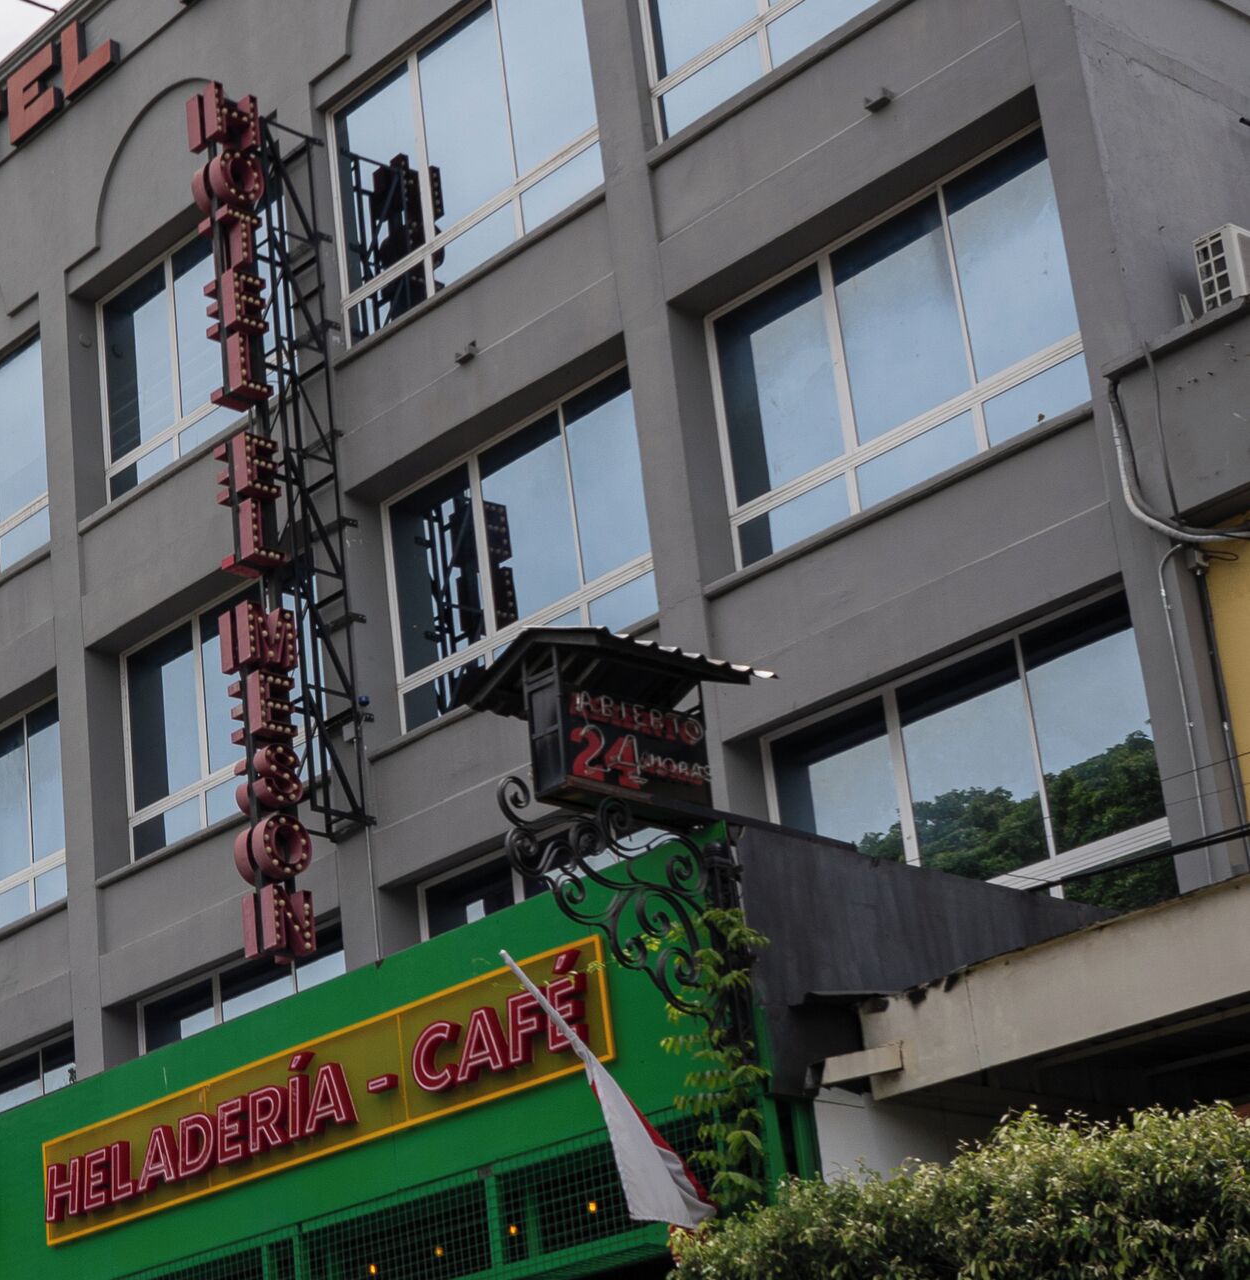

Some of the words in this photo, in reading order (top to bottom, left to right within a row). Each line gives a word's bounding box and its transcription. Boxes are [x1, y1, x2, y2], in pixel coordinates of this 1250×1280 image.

[186, 80, 274, 412] HOTEL
[214, 431, 286, 578] EL
[218, 599, 317, 964] MESON
[569, 691, 705, 746] ABIERTO
[570, 723, 648, 790] 24
[46, 1051, 358, 1223] HELADERÍA
[411, 948, 591, 1093] CAFÉ
